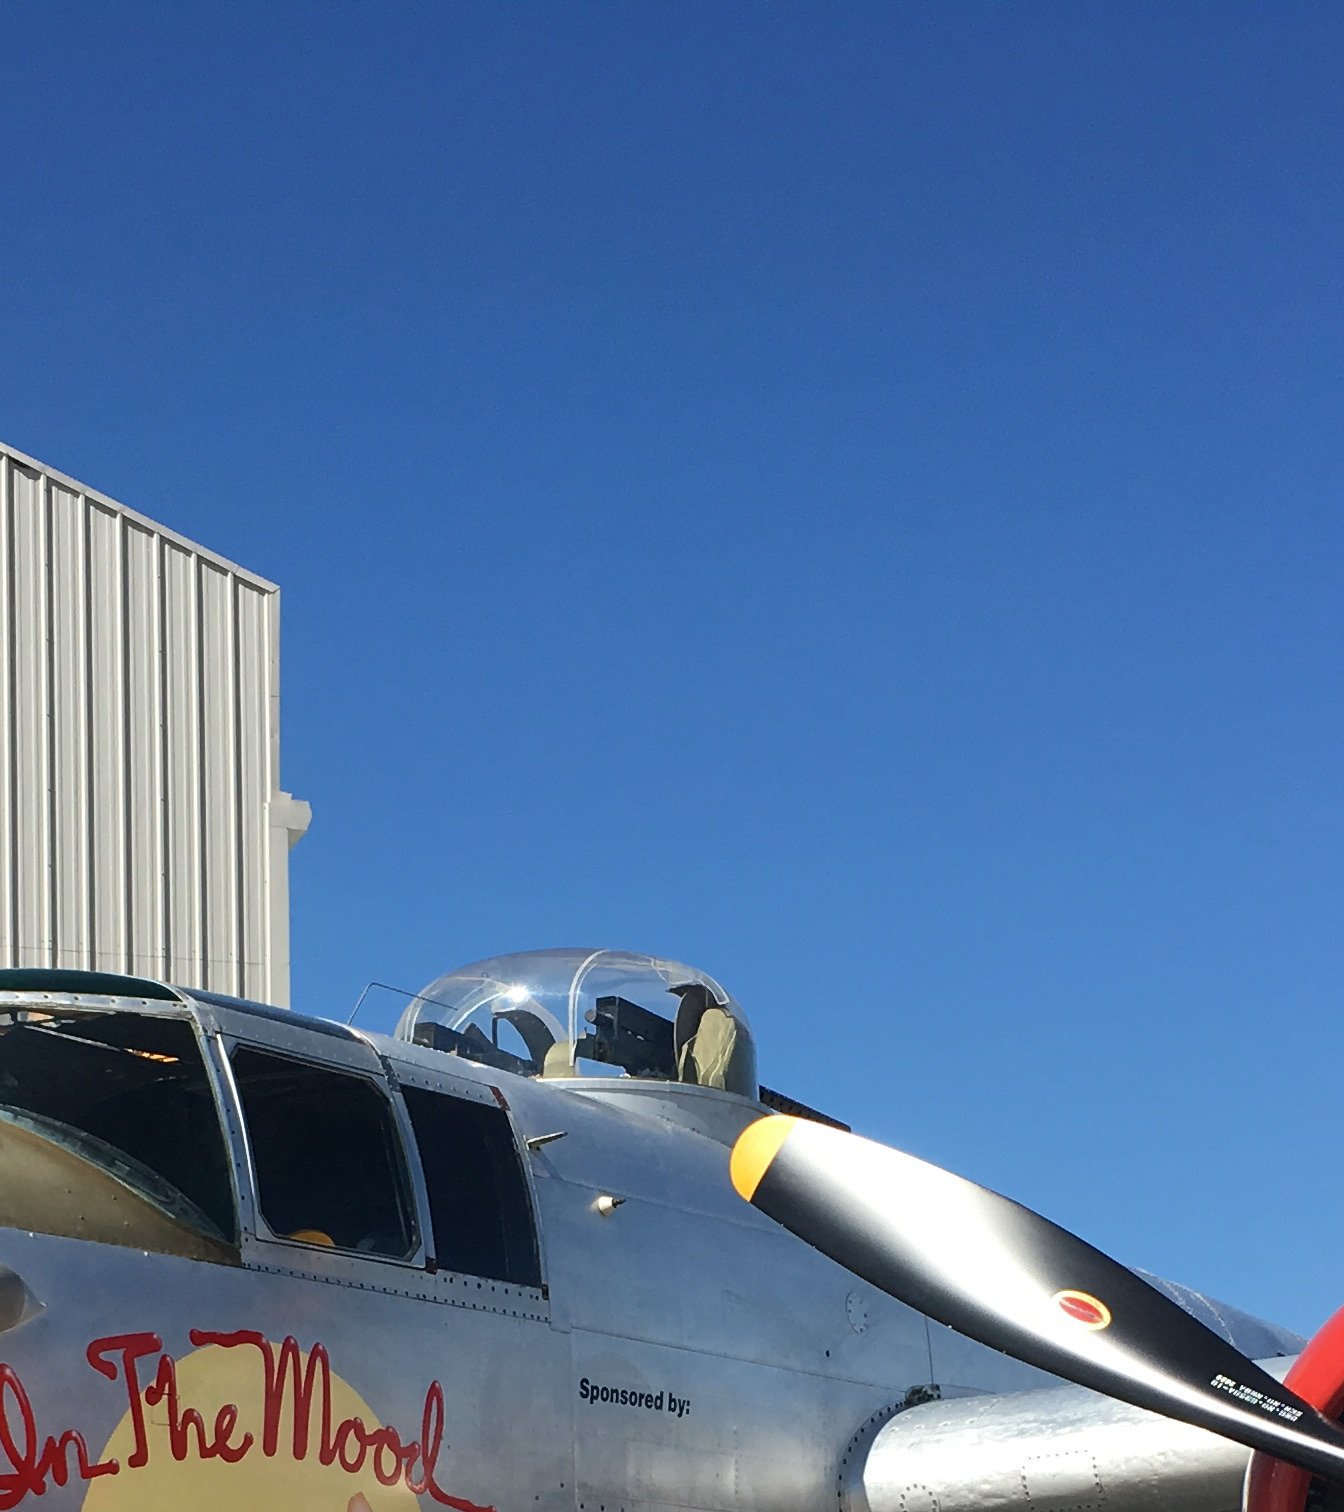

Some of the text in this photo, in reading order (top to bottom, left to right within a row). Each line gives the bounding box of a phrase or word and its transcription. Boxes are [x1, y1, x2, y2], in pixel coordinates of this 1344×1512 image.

[87, 1332, 253, 1467] The
[579, 1377, 691, 1418] Sponsored by:
